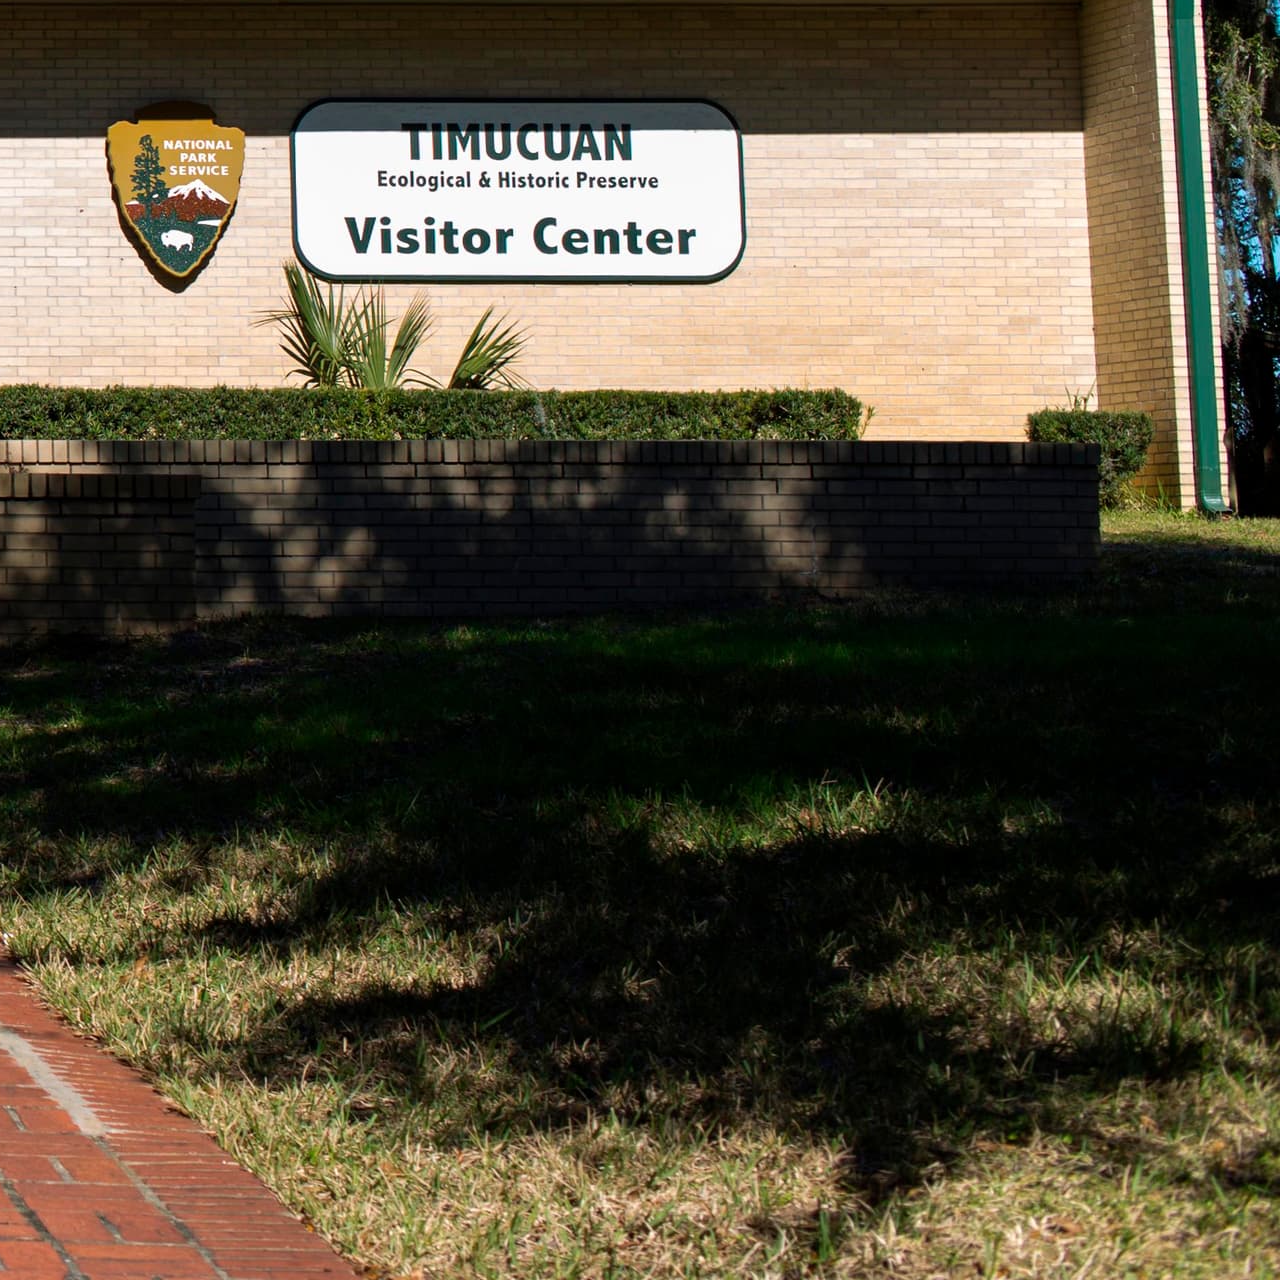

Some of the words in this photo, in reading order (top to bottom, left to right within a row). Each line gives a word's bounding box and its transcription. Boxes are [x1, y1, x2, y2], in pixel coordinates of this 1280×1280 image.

[163, 140, 233, 150] NATIONAL
[401, 122, 633, 161] TIMUCUAN
[180, 153, 216, 162] PARK
[169, 165, 229, 176] SERVICE
[377, 170, 471, 192] Ecological
[478, 172, 491, 188] &
[498, 171, 569, 189] Historic
[576, 172, 659, 189] Preserve
[344, 216, 514, 255] Visitor
[534, 217, 697, 255] Center
